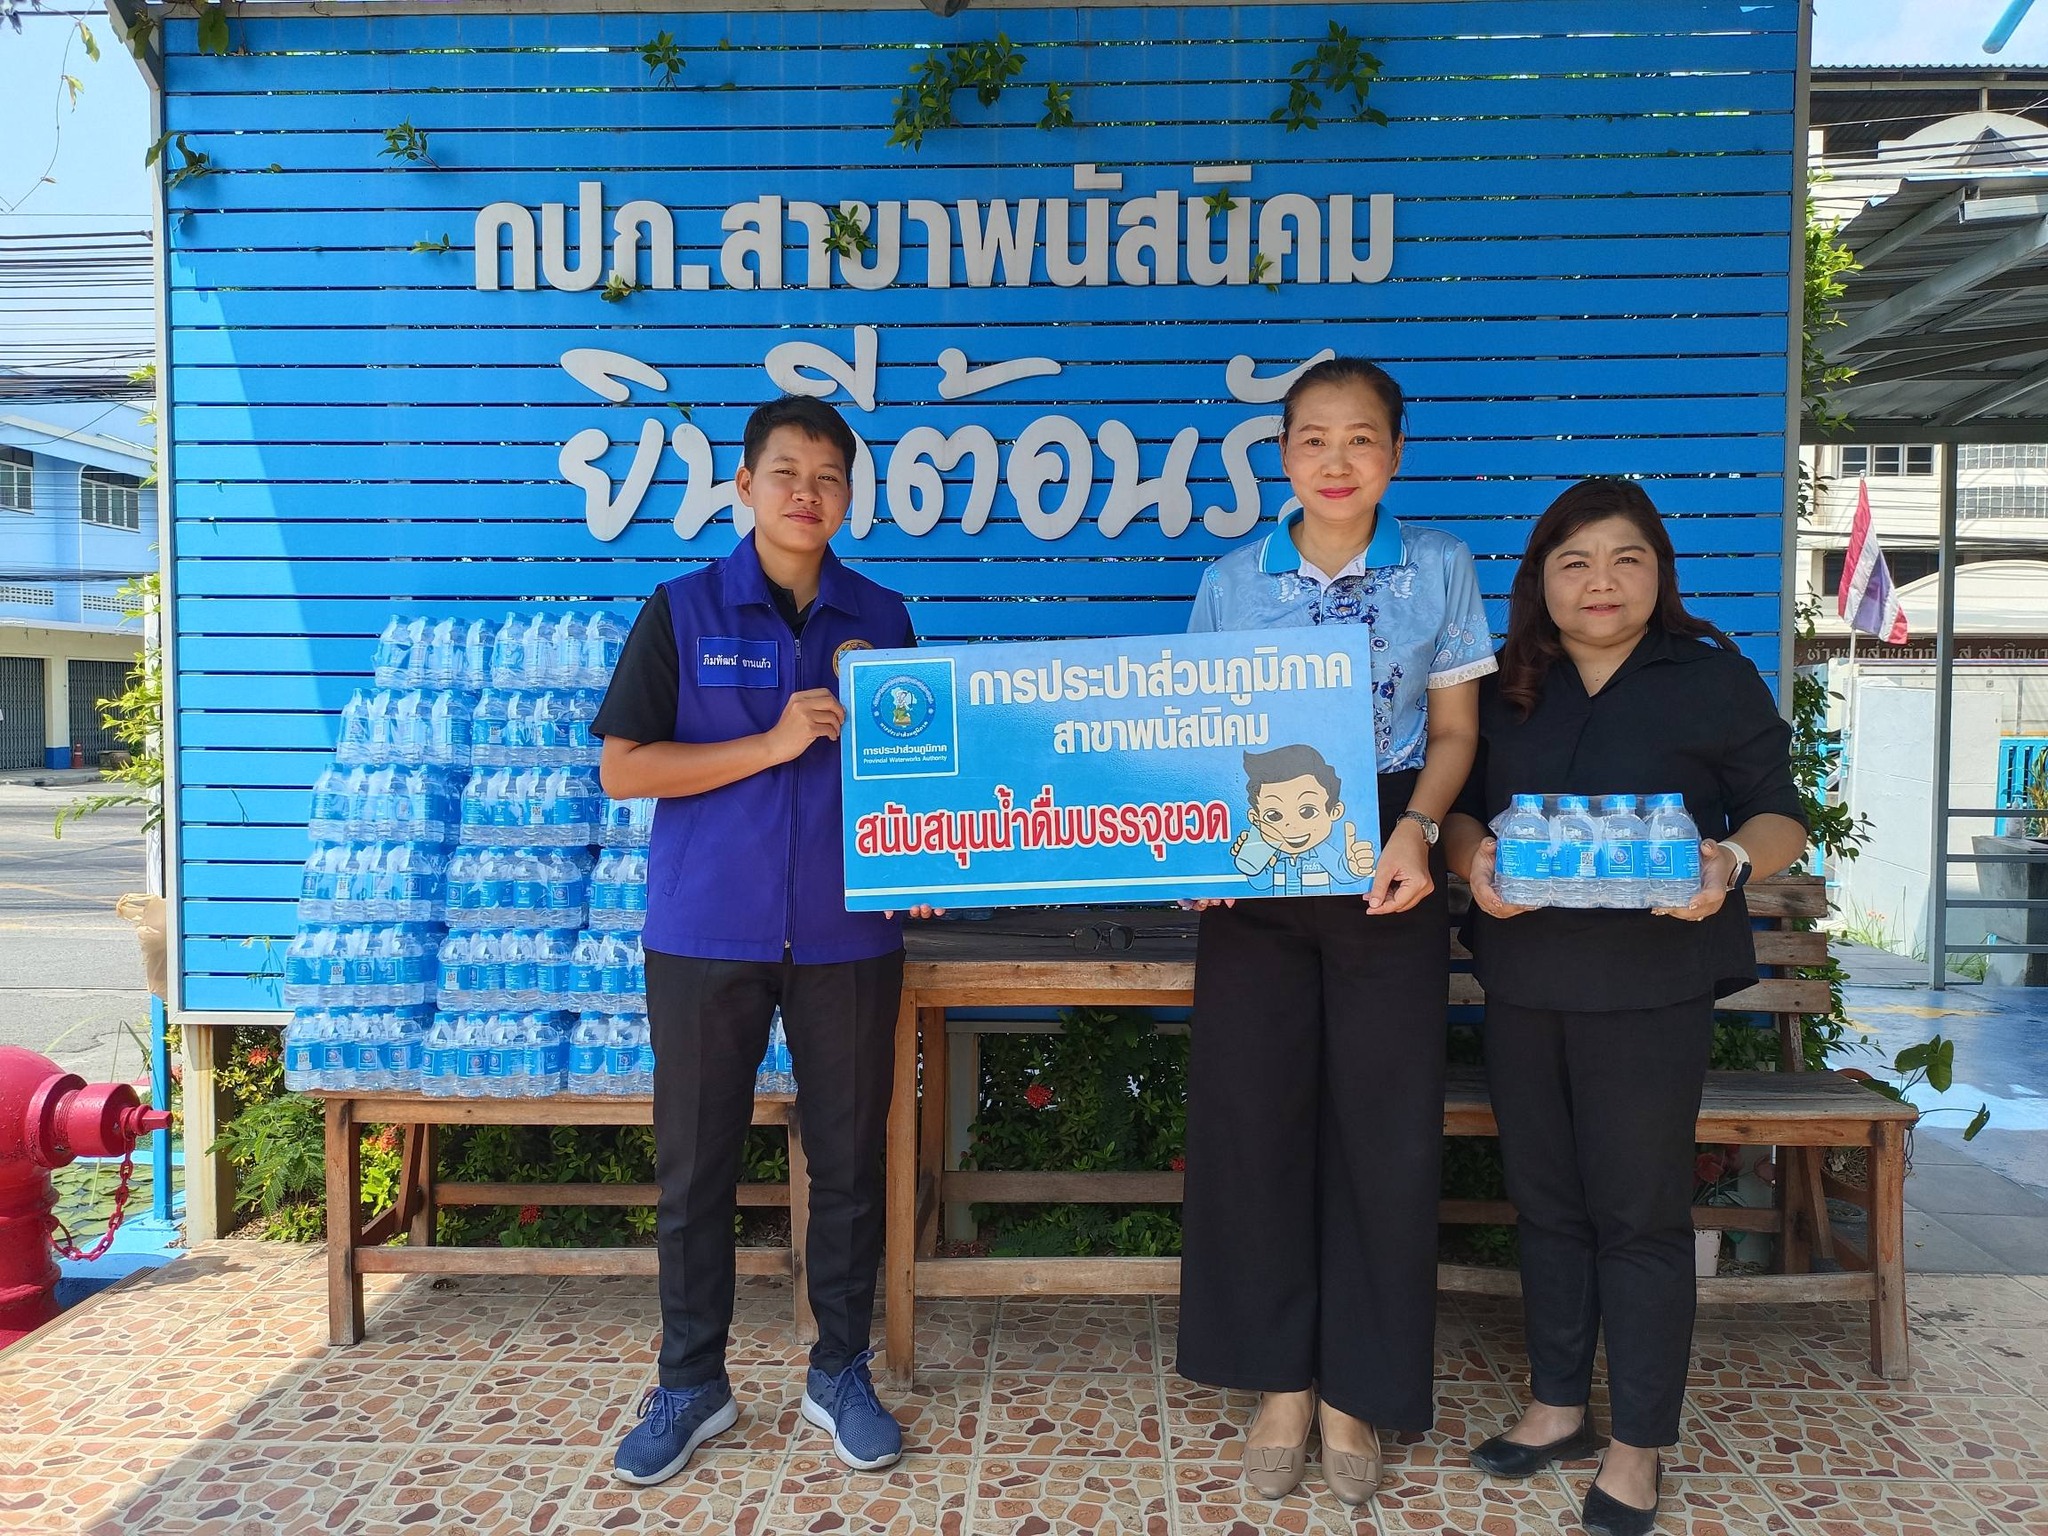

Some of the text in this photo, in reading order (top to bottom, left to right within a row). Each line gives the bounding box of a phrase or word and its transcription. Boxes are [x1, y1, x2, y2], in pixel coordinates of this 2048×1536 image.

[475, 163, 1395, 292] กปภ.สาขาพนัสนิคม
[558, 325, 1336, 543] ยินีต้อนรั
[969, 646, 1352, 706] การประปาส่วนภูมิภาค
[863, 744, 947, 756] การประปาส่วนภูมิภาค
[1053, 705, 1269, 754] สาขาพนัสนิคม
[857, 785, 1231, 867] สนับสนุนน้ำดื่มบรรจุขวด
